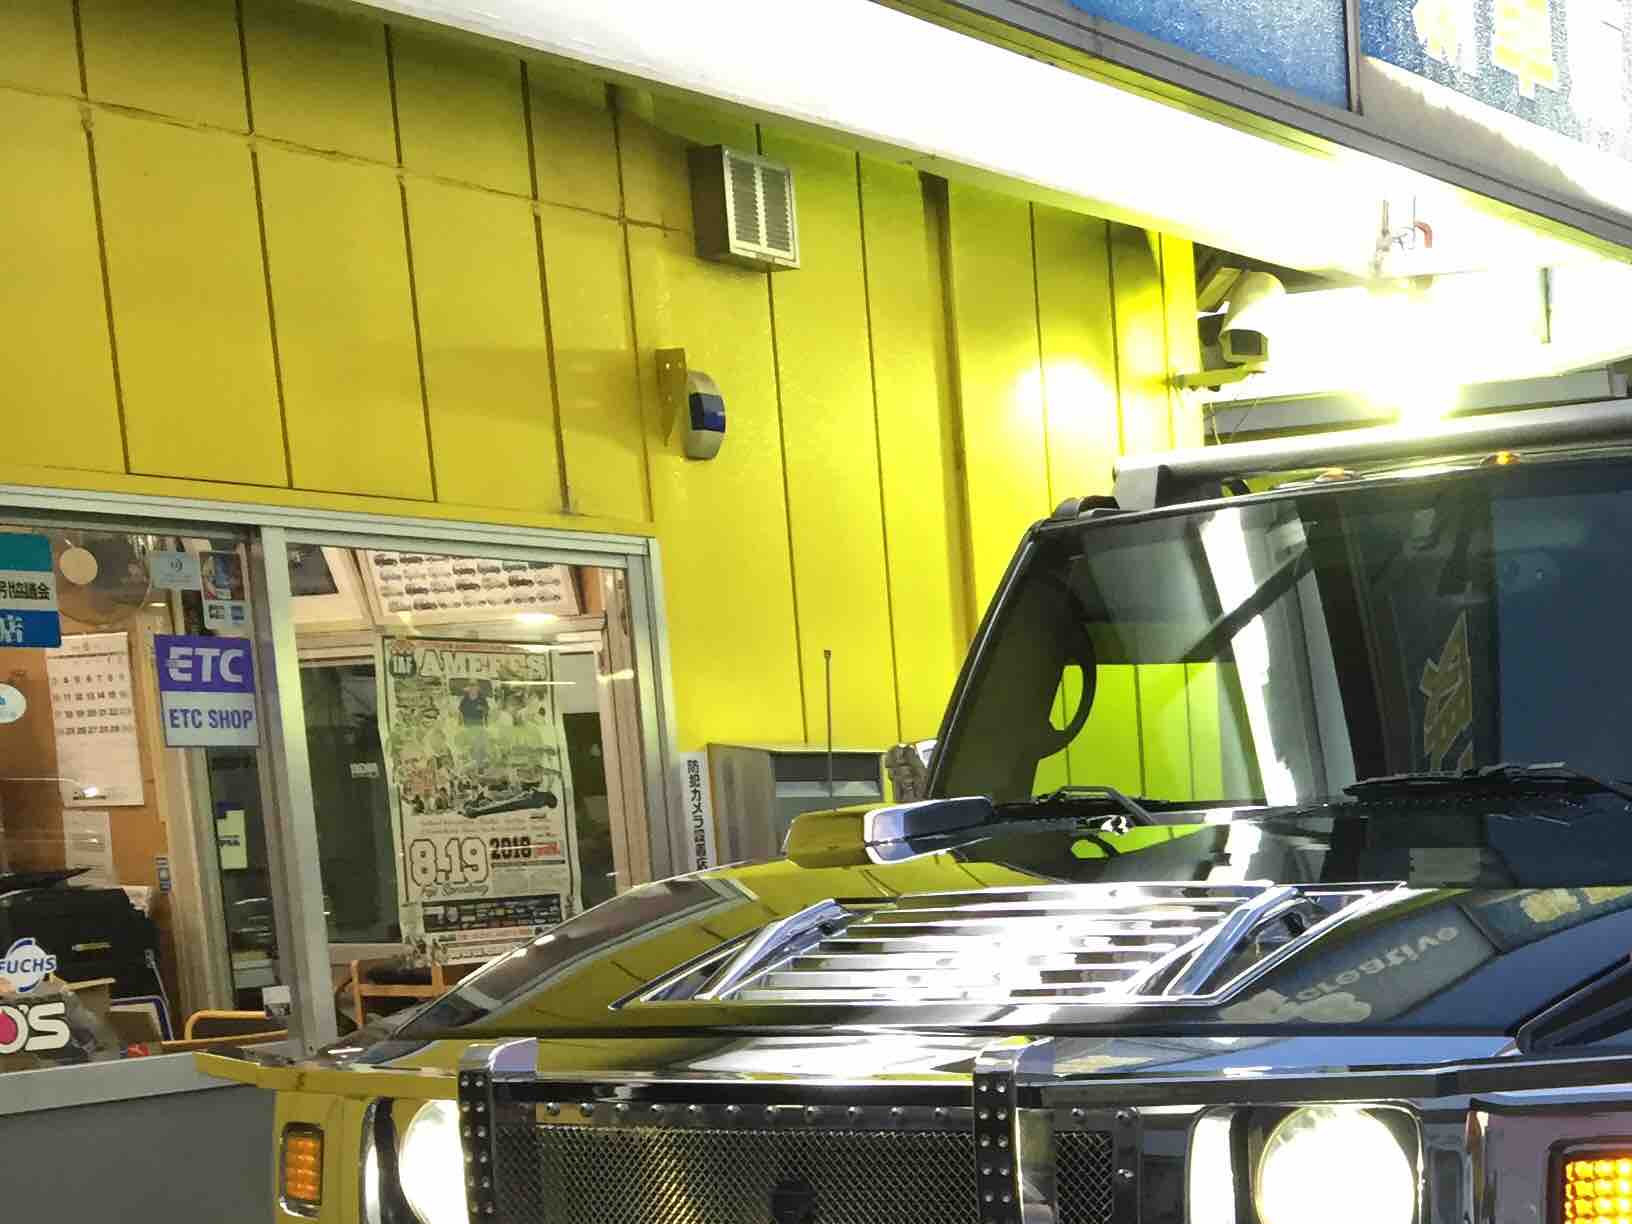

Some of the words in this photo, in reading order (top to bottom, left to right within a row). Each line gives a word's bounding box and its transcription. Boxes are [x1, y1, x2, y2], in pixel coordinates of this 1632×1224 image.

[166, 646, 245, 684] ETC
[169, 708, 203, 729] ETC
[208, 708, 253, 729] SHOP
[410, 836, 489, 887] 8.19
[489, 836, 532, 860] 2018
